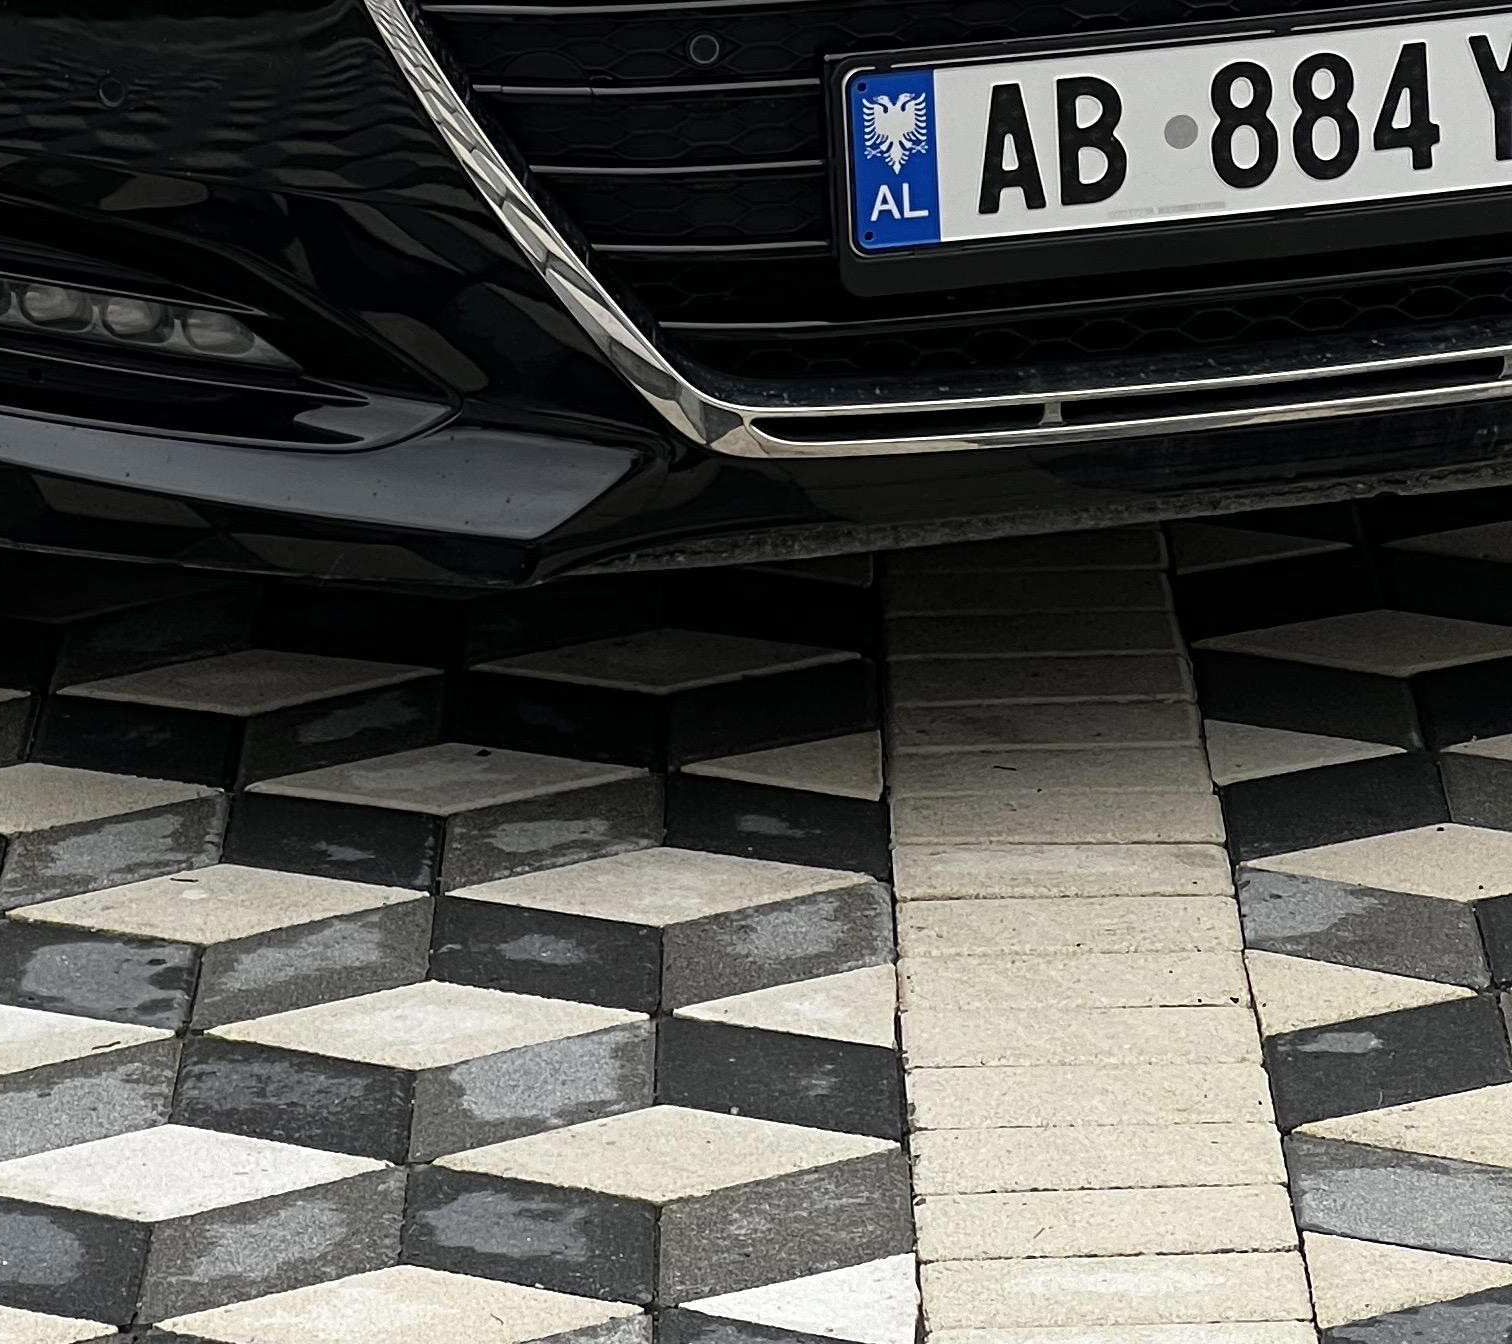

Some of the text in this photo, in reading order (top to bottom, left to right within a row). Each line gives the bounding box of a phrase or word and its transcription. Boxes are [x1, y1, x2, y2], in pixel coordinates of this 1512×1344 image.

[978, 75, 1128, 215] AB
[1210, 41, 1441, 190] 884
[870, 182, 929, 222] AL
